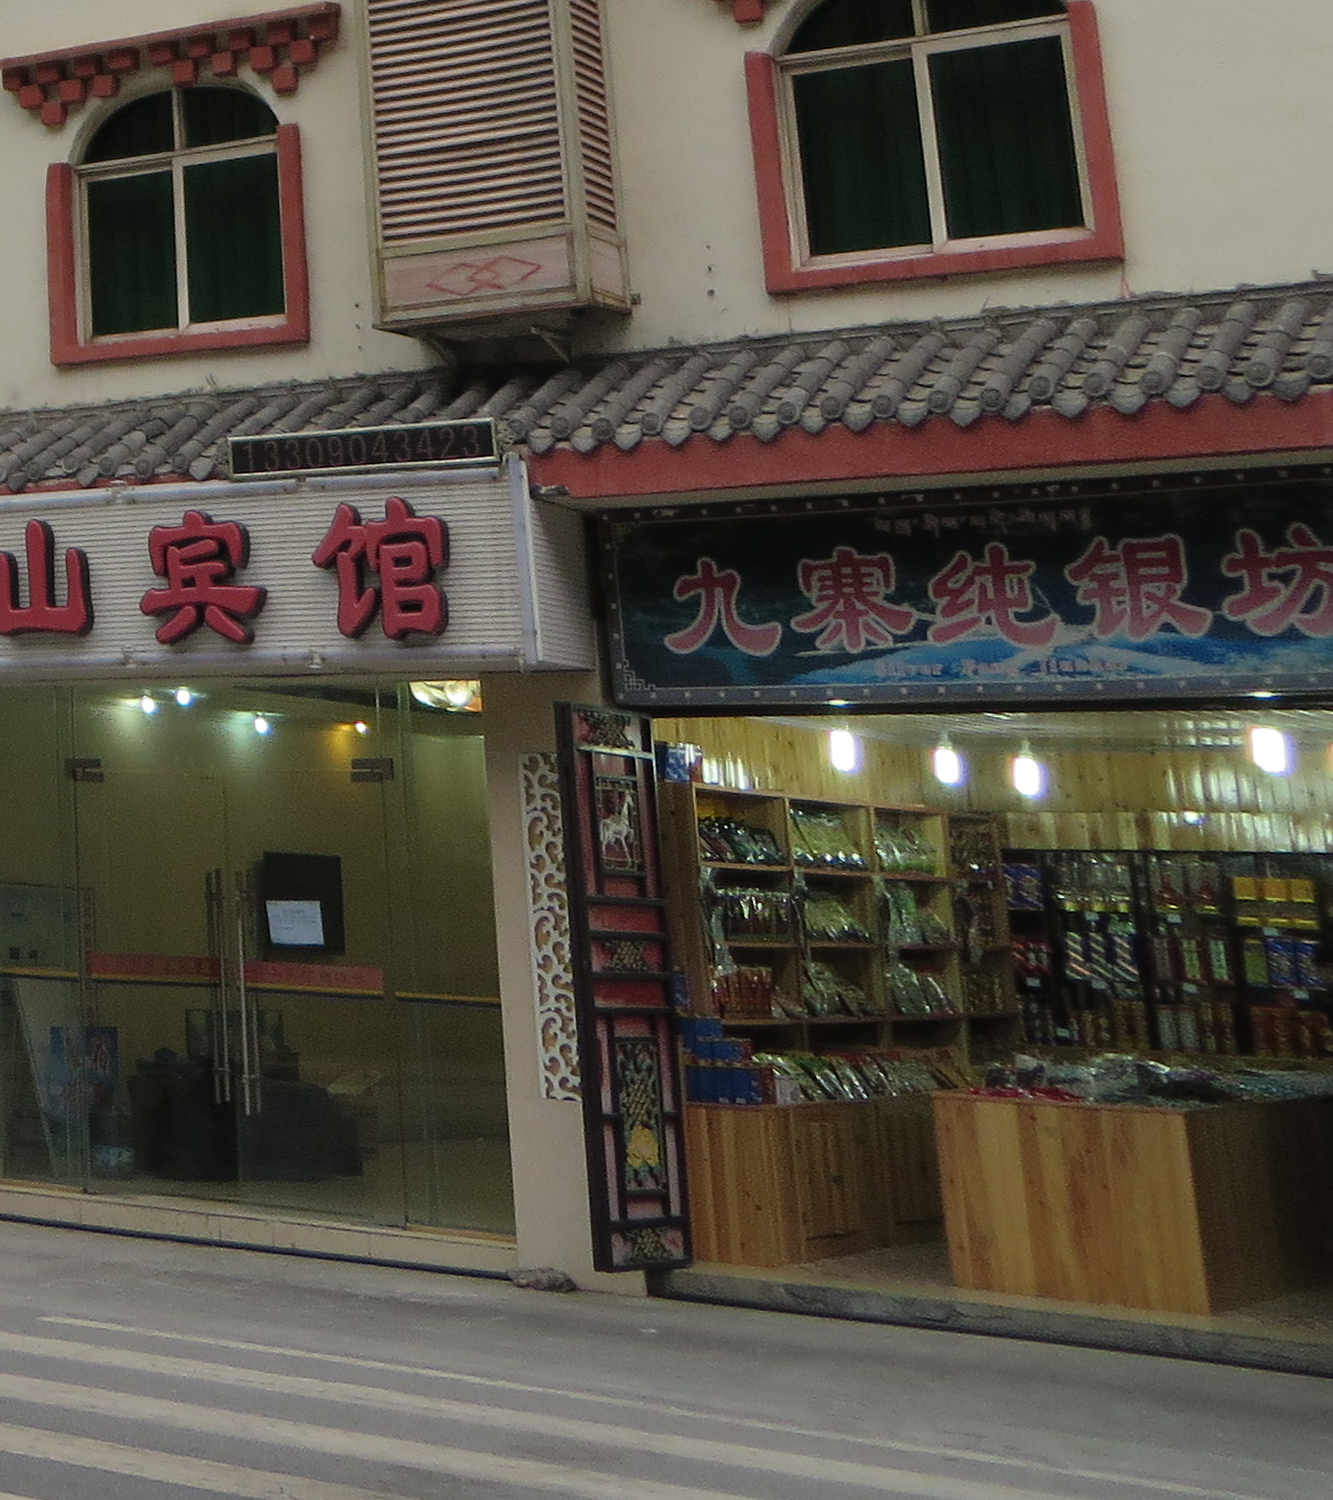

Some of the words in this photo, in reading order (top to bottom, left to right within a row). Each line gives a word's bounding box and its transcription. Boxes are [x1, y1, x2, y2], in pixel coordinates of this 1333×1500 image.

[242, 425, 482, 472] 13309043423
[664, 522, 1333, 656] 九寨纯银坊
